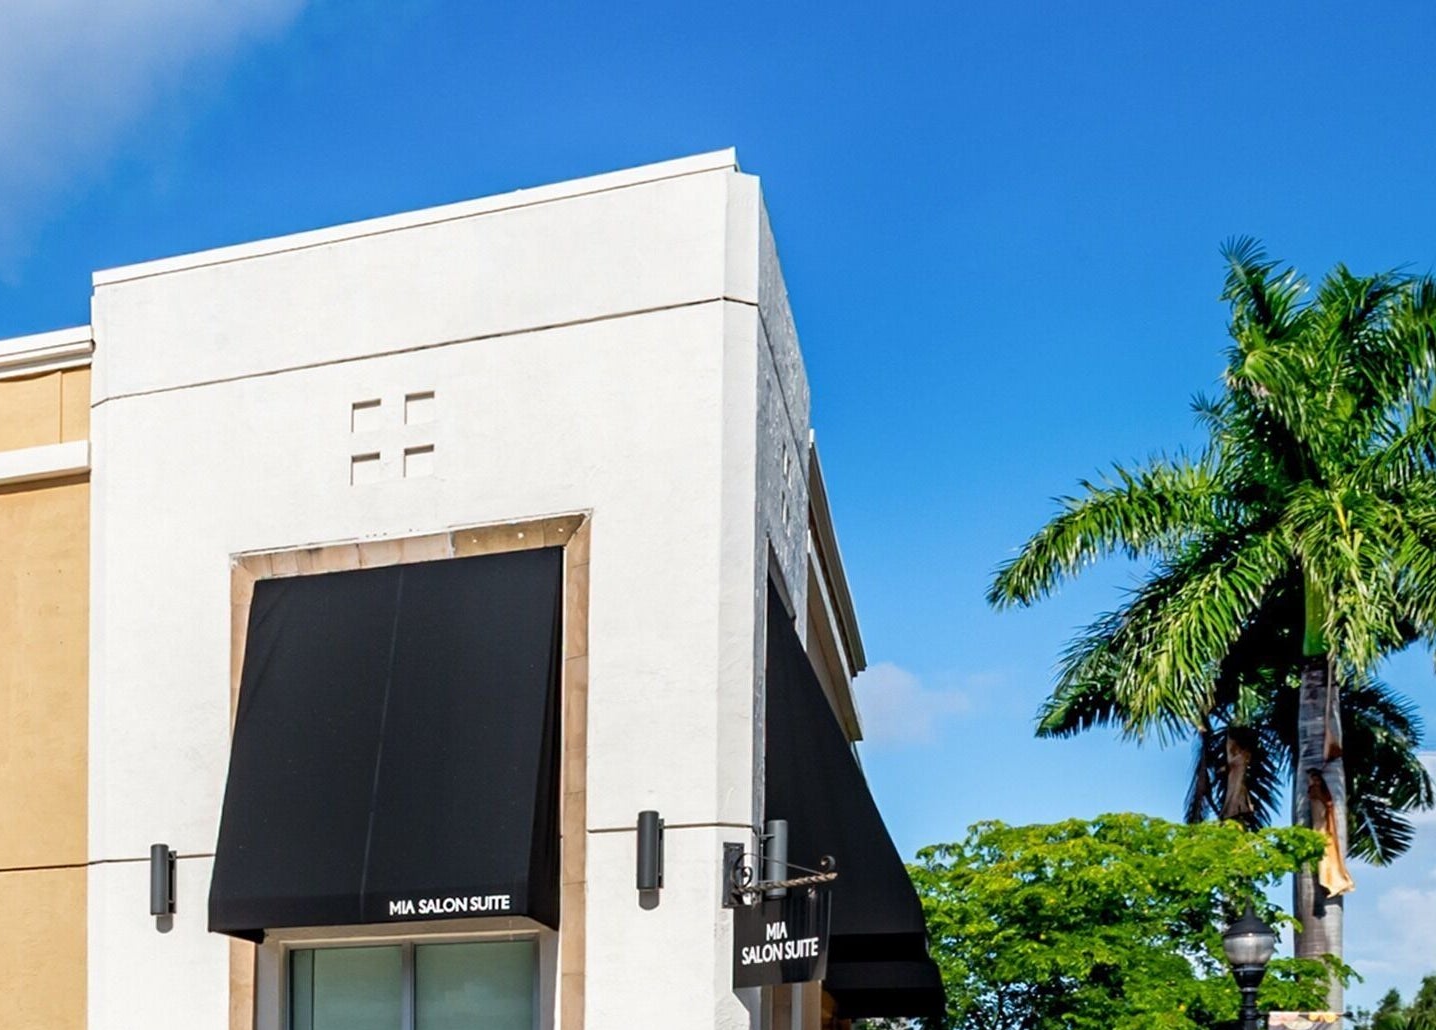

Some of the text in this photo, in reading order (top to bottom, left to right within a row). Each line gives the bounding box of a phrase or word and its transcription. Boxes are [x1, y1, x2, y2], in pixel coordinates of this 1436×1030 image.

[389, 895, 510, 915] MIA SALON SUITE
[766, 921, 788, 941] MIA
[742, 937, 819, 965] SALON SUITE
